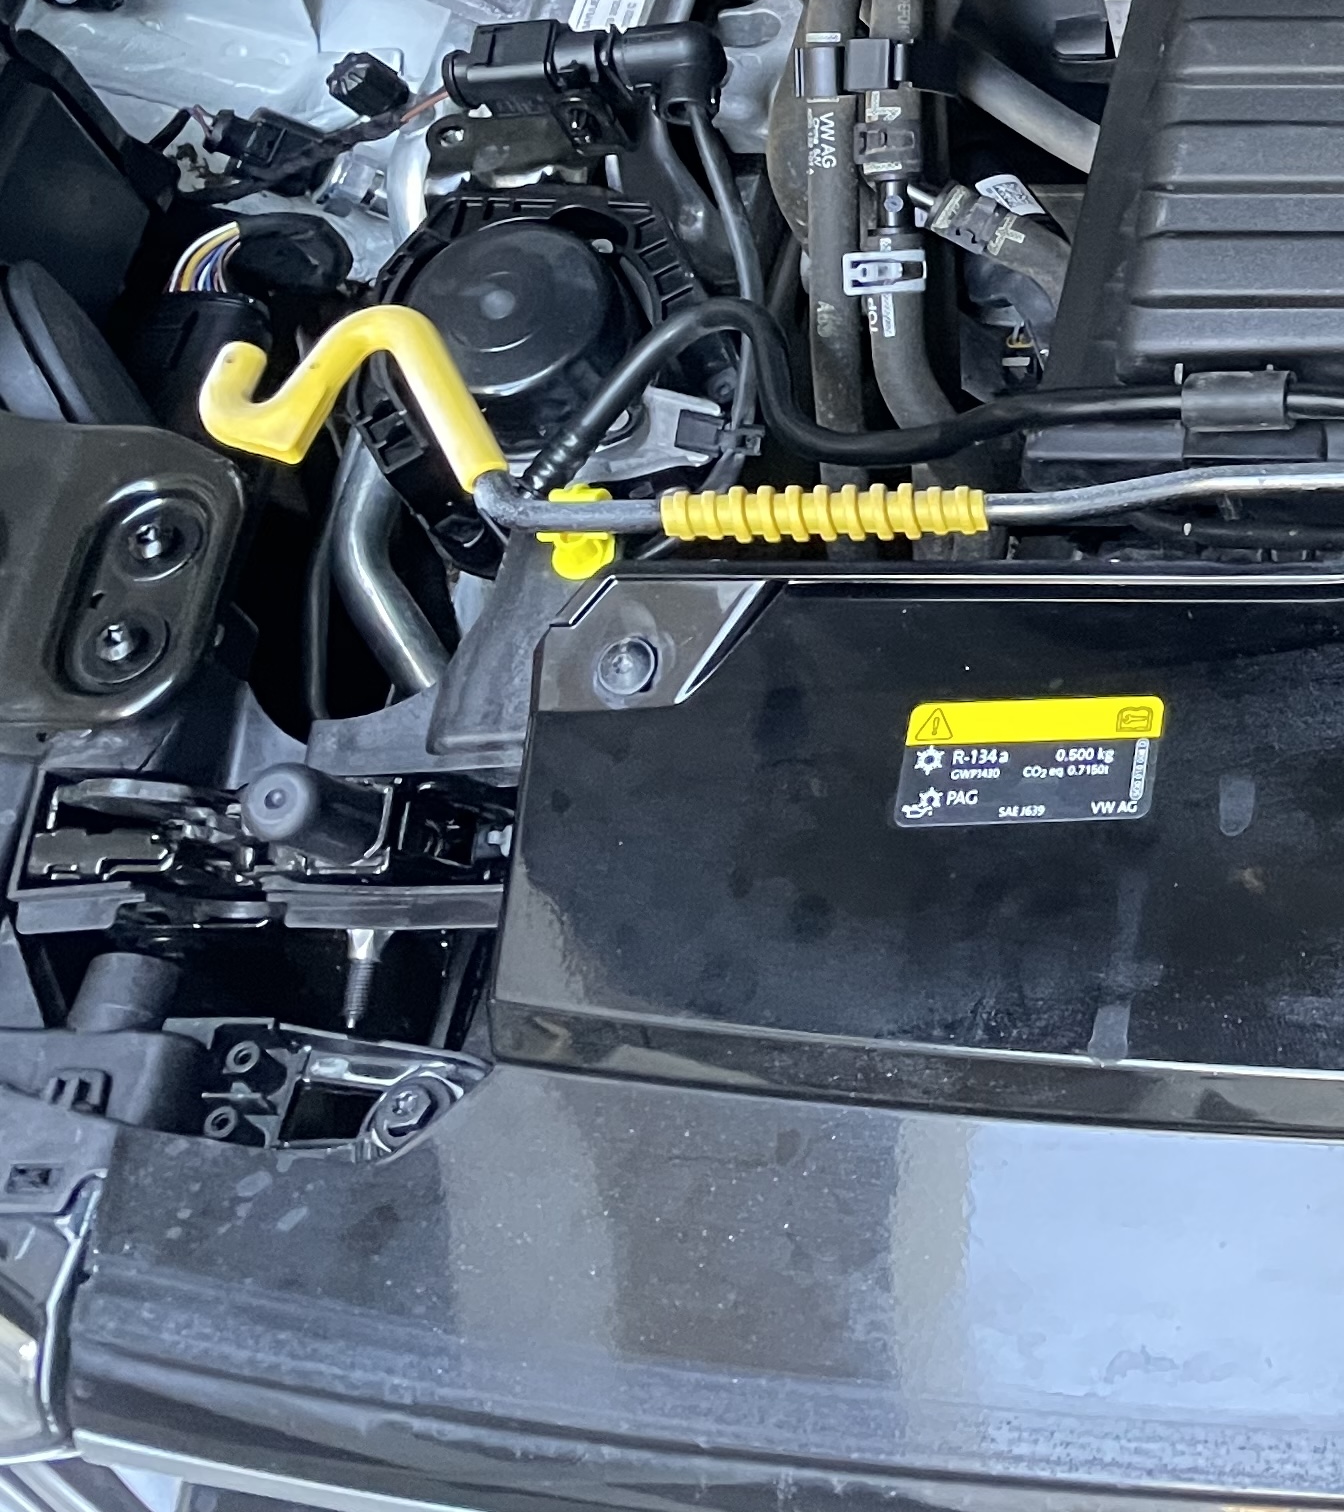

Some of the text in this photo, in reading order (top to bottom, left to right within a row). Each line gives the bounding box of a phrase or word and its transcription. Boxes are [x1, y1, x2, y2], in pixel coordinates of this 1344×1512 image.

[819, 112, 837, 169] VW AG
[1055, 747, 1095, 763] 0.500
[1097, 746, 1115, 763] kg
[946, 788, 978, 806] PAG
[998, 805, 1019, 818] SAE
[1091, 800, 1138, 815] VW AG
